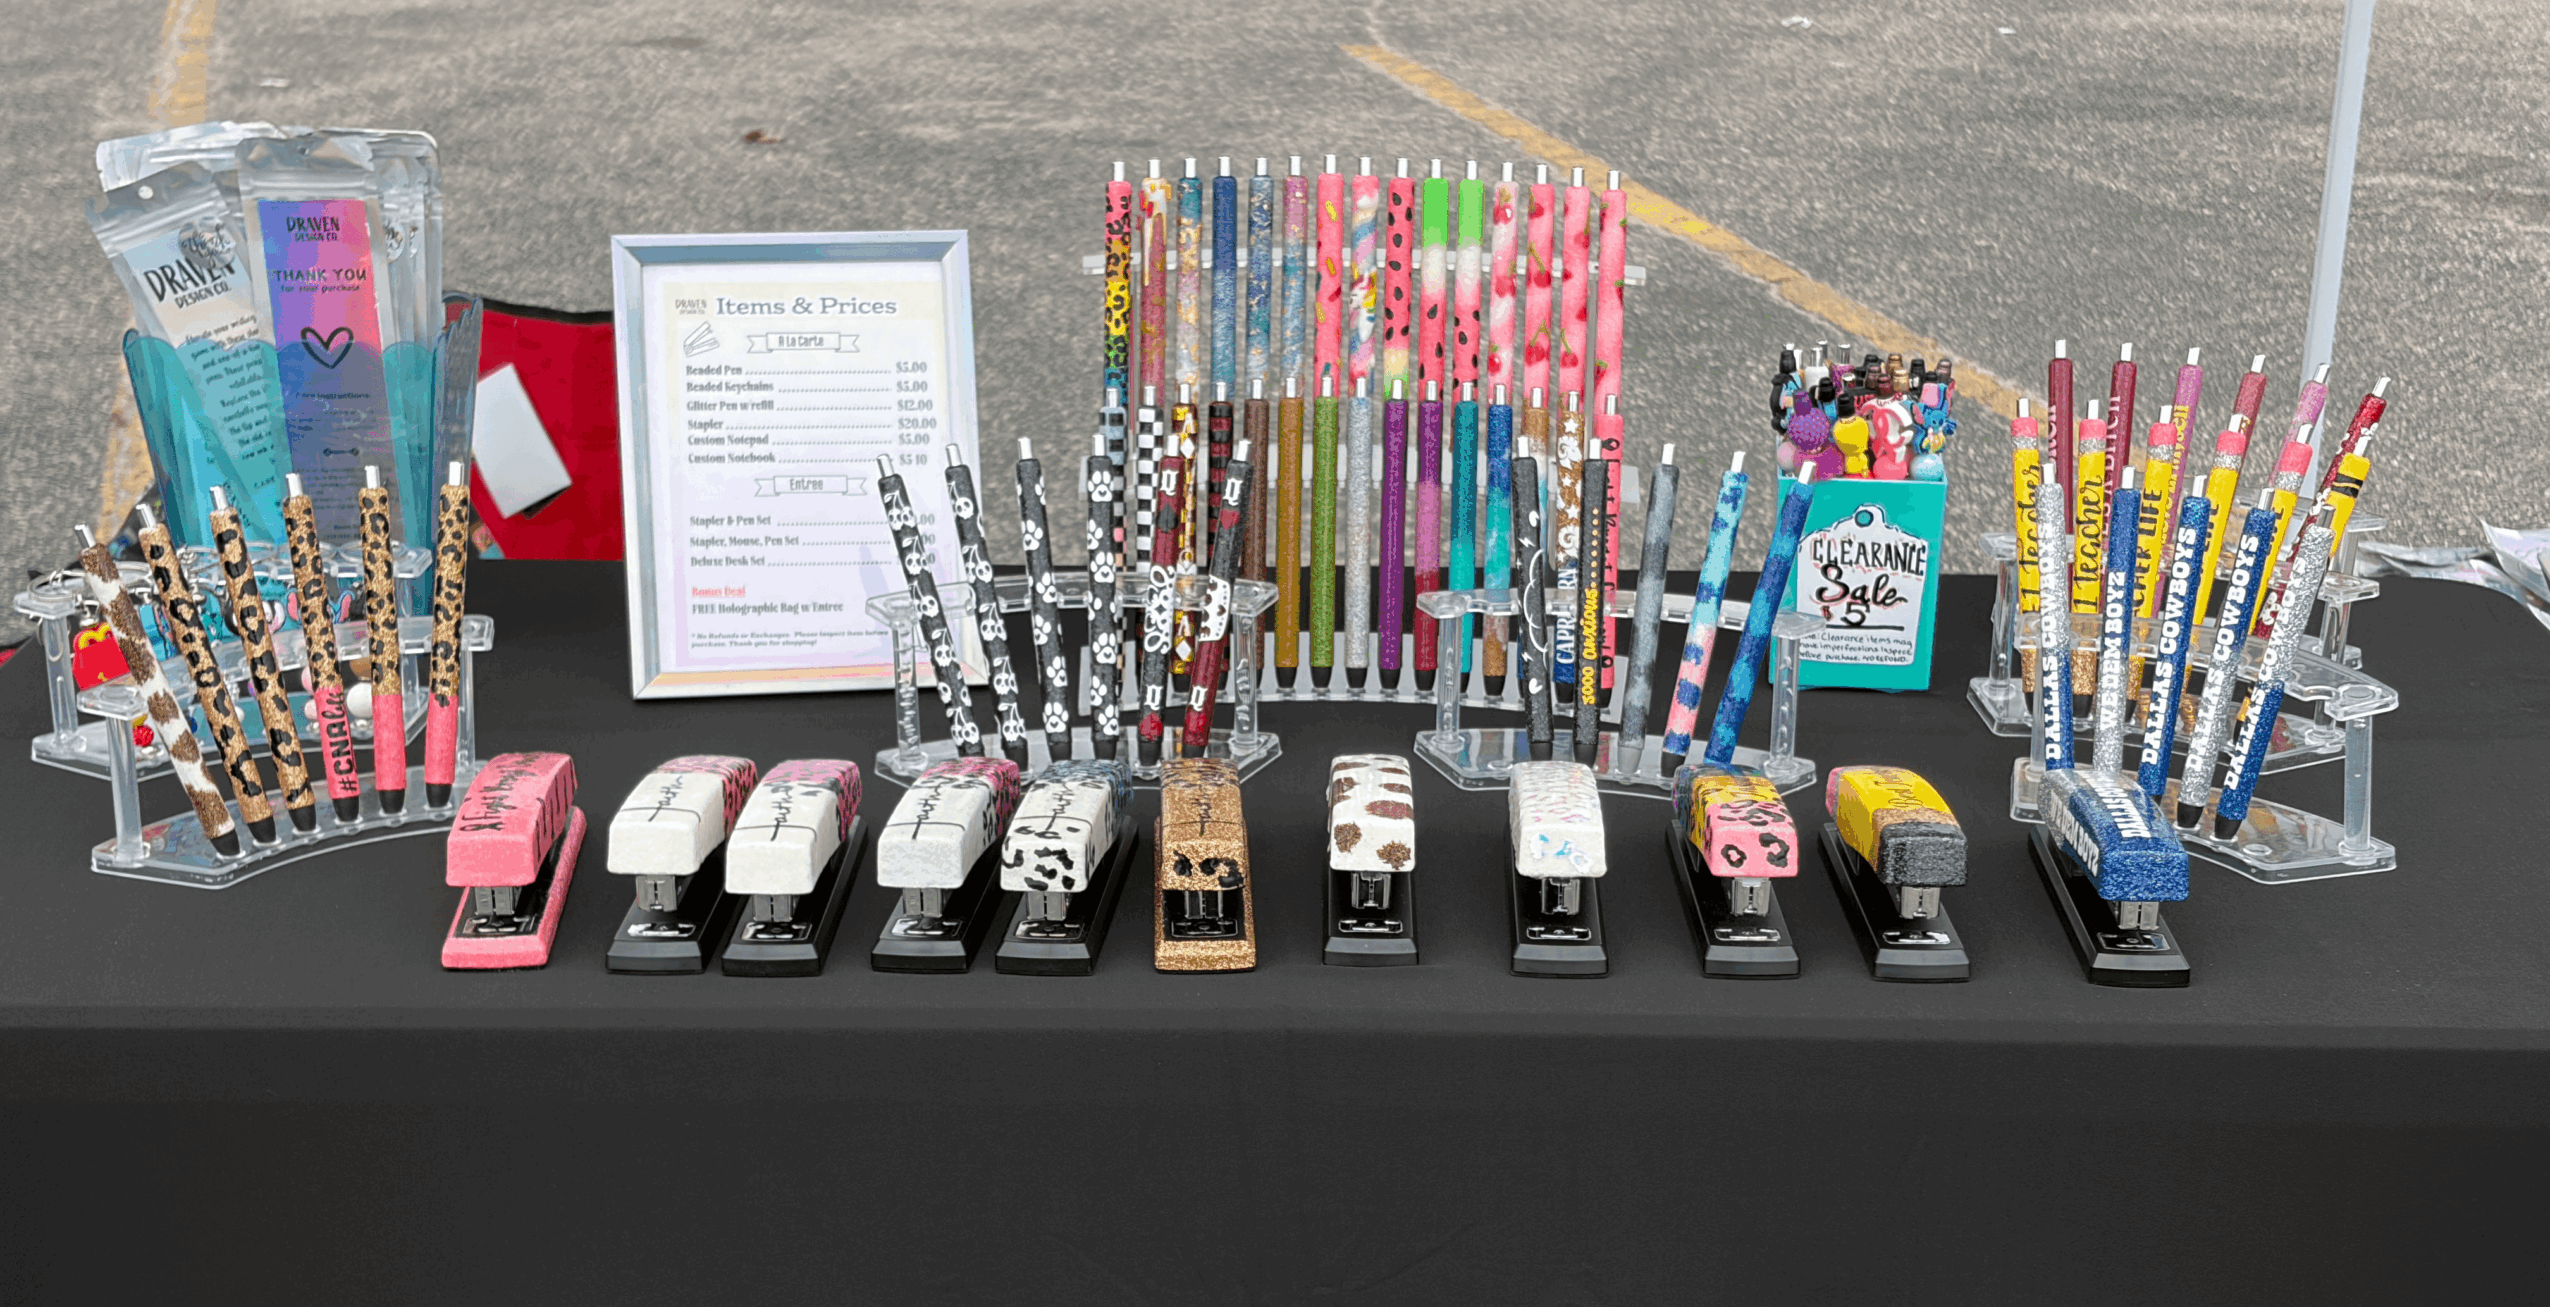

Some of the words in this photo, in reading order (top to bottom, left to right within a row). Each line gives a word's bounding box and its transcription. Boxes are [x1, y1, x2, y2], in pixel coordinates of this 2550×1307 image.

[286, 216, 340, 232] DRAVEN
[274, 270, 326, 282] THANK
[332, 268, 366, 280] YOU
[174, 286, 214, 308] DESIGN
[214, 281, 232, 295] CO.
[716, 298, 785, 315] Items
[792, 297, 813, 314] &
[820, 297, 897, 314] Prices
[786, 336, 796, 347] La
[798, 336, 824, 347] Carte
[686, 365, 722, 376] Beaded
[724, 365, 742, 375] Pen
[896, 361, 927, 373] $5.00
[686, 382, 722, 392] Beaded
[725, 381, 774, 393] Keychains
[897, 381, 928, 392] $5.00
[687, 400, 717, 412] Glitter
[720, 401, 738, 411] Pen
[898, 400, 933, 412] $12.00
[688, 420, 724, 432] Stapler
[898, 418, 936, 430] $20.00
[688, 435, 725, 446] Custom
[727, 434, 769, 447] Notepad
[899, 434, 930, 445] $5.00
[688, 454, 726, 464] Custom
[727, 453, 776, 463] Notebook
[790, 478, 823, 491] Entree
[2139, 488, 2162, 536] LIFE
[690, 516, 725, 528] Stapler
[727, 516, 734, 525] &
[736, 516, 754, 525] Pen
[757, 516, 771, 525] Set
[2074, 475, 2102, 590] Teacher
[690, 537, 726, 548] Stapler,
[729, 536, 762, 547] Mouse,
[764, 536, 782, 546] Pen
[785, 536, 799, 546] Set
[691, 557, 723, 566] Deluxe
[725, 557, 748, 566] Desk
[751, 556, 764, 566] Set
[1813, 537, 1926, 577] CLEARANCE
[1816, 564, 1908, 607] Sale
[2038, 523, 2057, 648] COWBOYS
[692, 604, 716, 614] FREE
[718, 602, 778, 615] Holographic
[781, 603, 799, 614] Bag
[2105, 571, 2126, 634] BOYZ
[1822, 632, 1863, 642] Clearance
[1867, 635, 1890, 644] items
[2141, 661, 2173, 765] DALLAS
[2160, 527, 2196, 654] COWBOYS
[2186, 668, 2225, 774] DALLAS
[2213, 534, 2260, 662] COWBOYS
[2102, 637, 2121, 694] DEM
[2224, 686, 2266, 790] DALLAS
[2258, 556, 2306, 682] COWBOYS
[2042, 656, 2062, 760] DALLAS
[2100, 694, 2118, 730] WE
[2101, 798, 2151, 838] DALLAS
[2077, 825, 2100, 878] BOYZ
